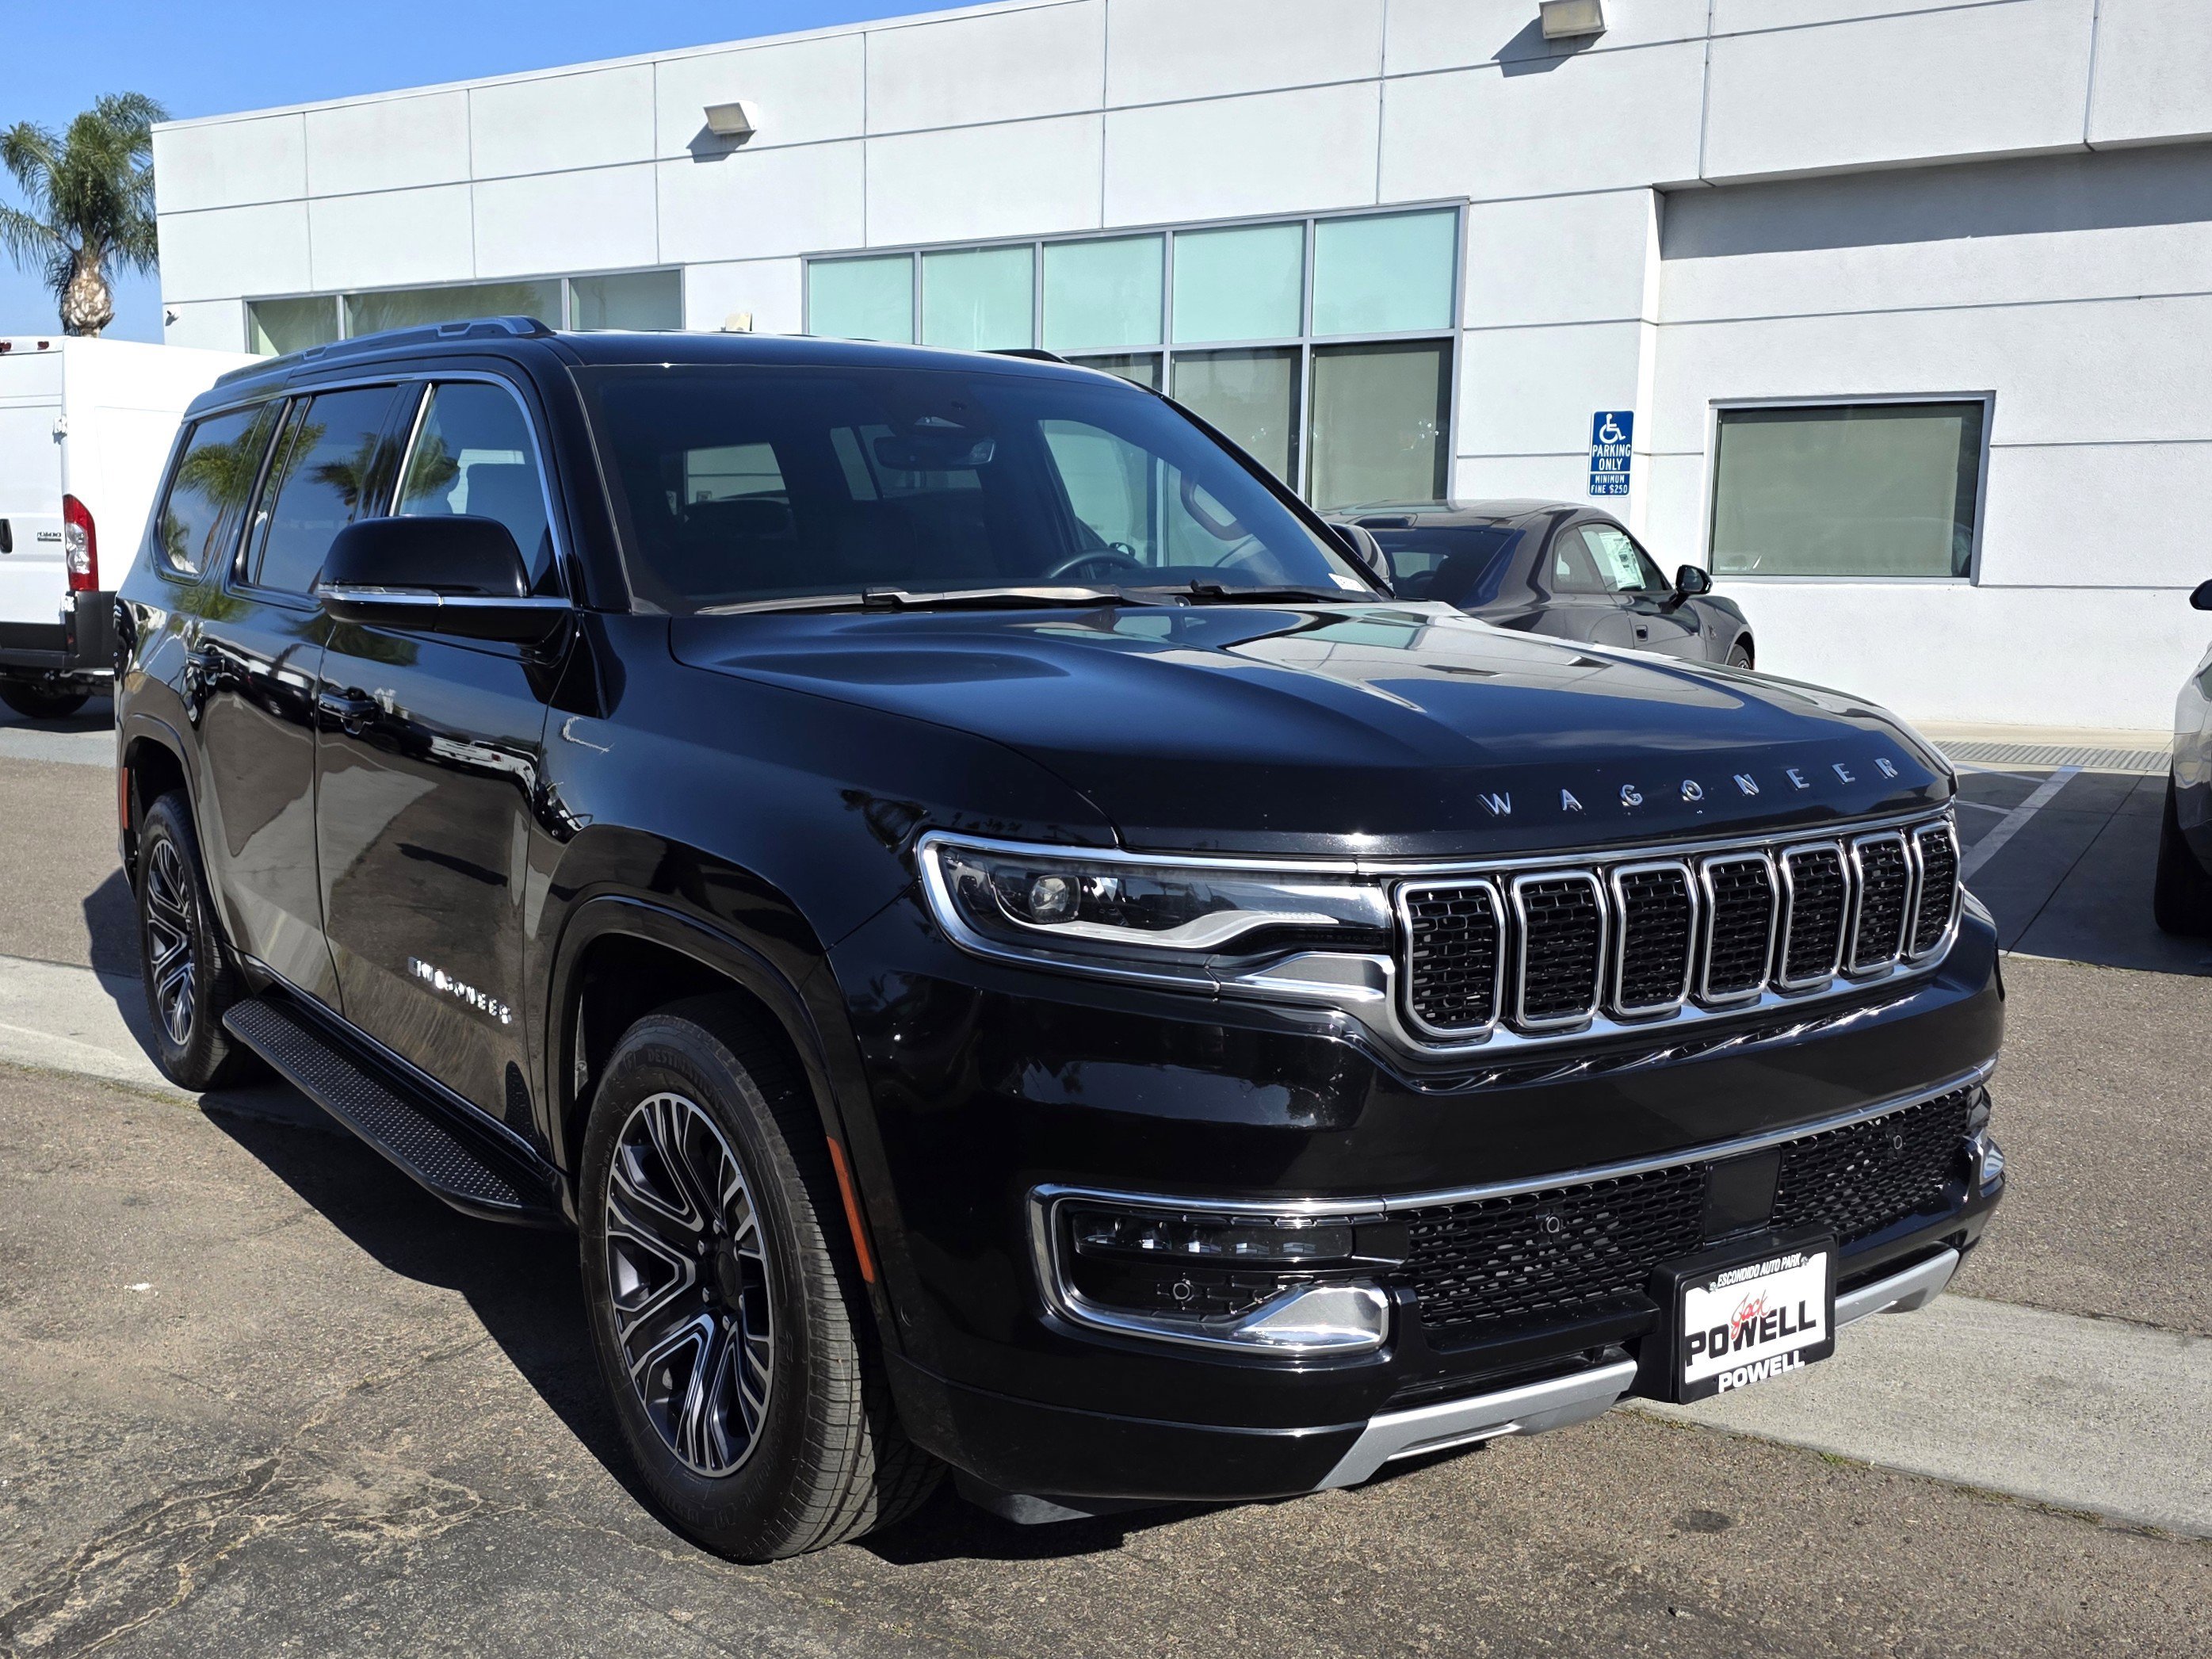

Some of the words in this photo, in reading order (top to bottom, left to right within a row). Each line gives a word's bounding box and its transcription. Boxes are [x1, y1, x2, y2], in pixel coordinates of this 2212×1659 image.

[1592, 444, 1631, 457] PARKING
[1599, 457, 1623, 471] ONLY
[1591, 484, 1606, 494] FINE
[1609, 484, 1628, 495] $250
[1595, 475, 1625, 484] MINIMUM
[1476, 757, 1899, 816] WAGONEER
[1717, 1263, 1761, 1288] ESCONDIDO
[1759, 1258, 1782, 1276] AUTO
[1779, 1252, 1801, 1271] PARK
[1730, 1289, 1771, 1340] Jack
[1685, 1300, 1817, 1367] POWELL
[1718, 1350, 1806, 1393] POWELL
